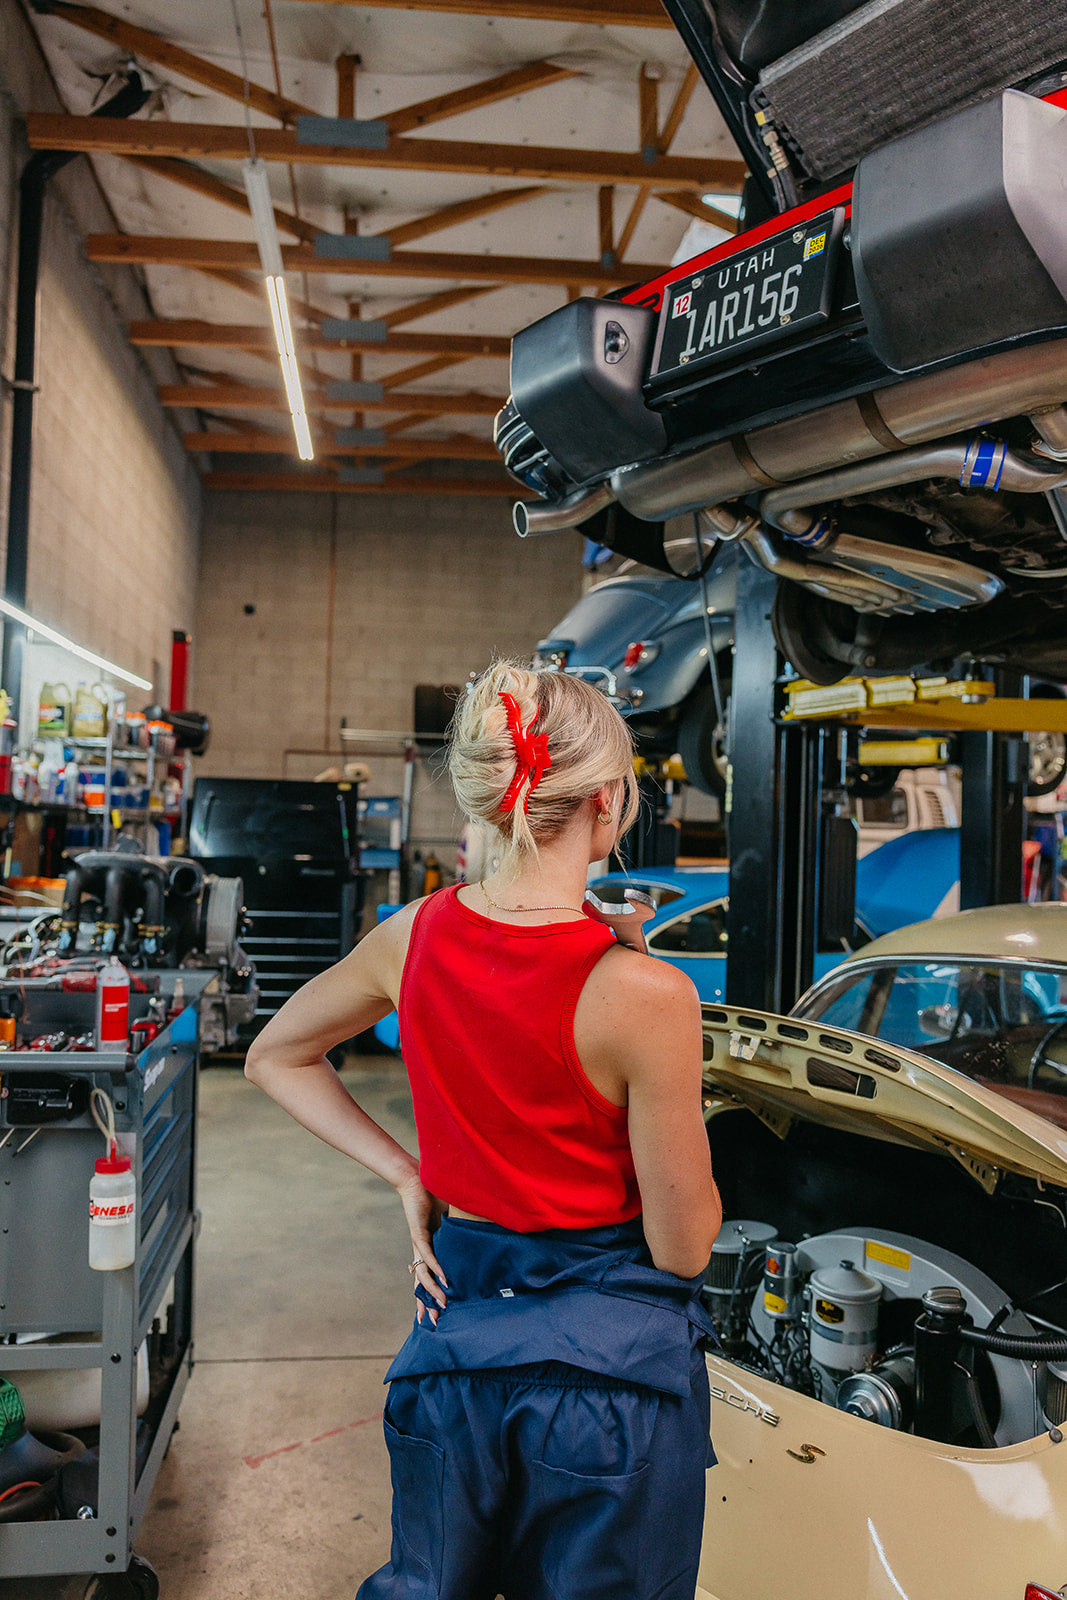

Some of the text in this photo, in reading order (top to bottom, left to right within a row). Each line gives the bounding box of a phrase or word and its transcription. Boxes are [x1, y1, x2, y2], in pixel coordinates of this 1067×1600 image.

[810, 235, 825, 248] DEC
[718, 248, 775, 289] UTAH
[675, 295, 690, 315] 12
[679, 264, 803, 358] 1AR156
[786, 1443, 827, 1464] S
